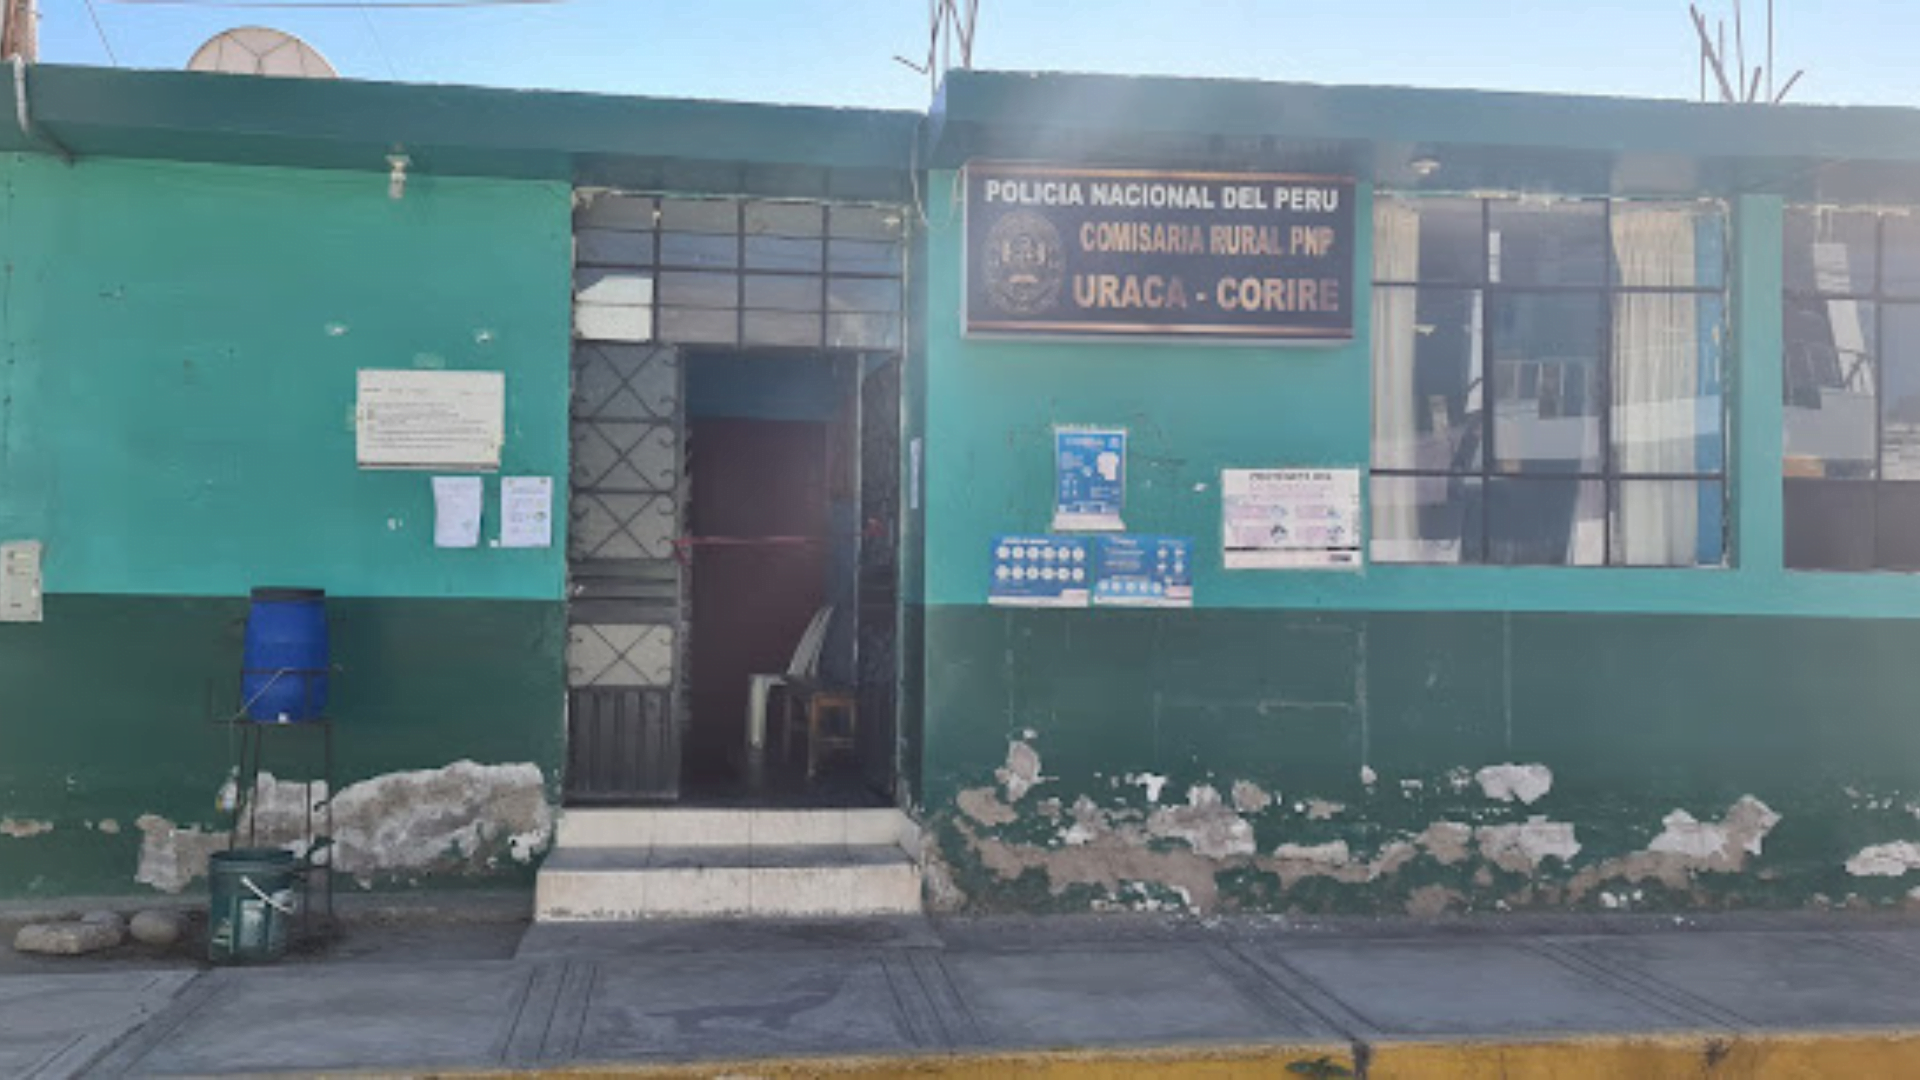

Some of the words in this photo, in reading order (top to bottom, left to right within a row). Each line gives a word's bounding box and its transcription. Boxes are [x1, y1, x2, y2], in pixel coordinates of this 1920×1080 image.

[986, 179, 1084, 206] POLICIA
[1090, 183, 1215, 209] NACIONAL
[1222, 186, 1268, 210] DEL
[1274, 187, 1340, 212] PERU
[1080, 222, 1204, 253] COMISARIA
[1210, 225, 1282, 255] RURAL
[1290, 227, 1335, 257] PNP
[1073, 275, 1188, 308] URACA
[1217, 277, 1340, 312] CORIRE
